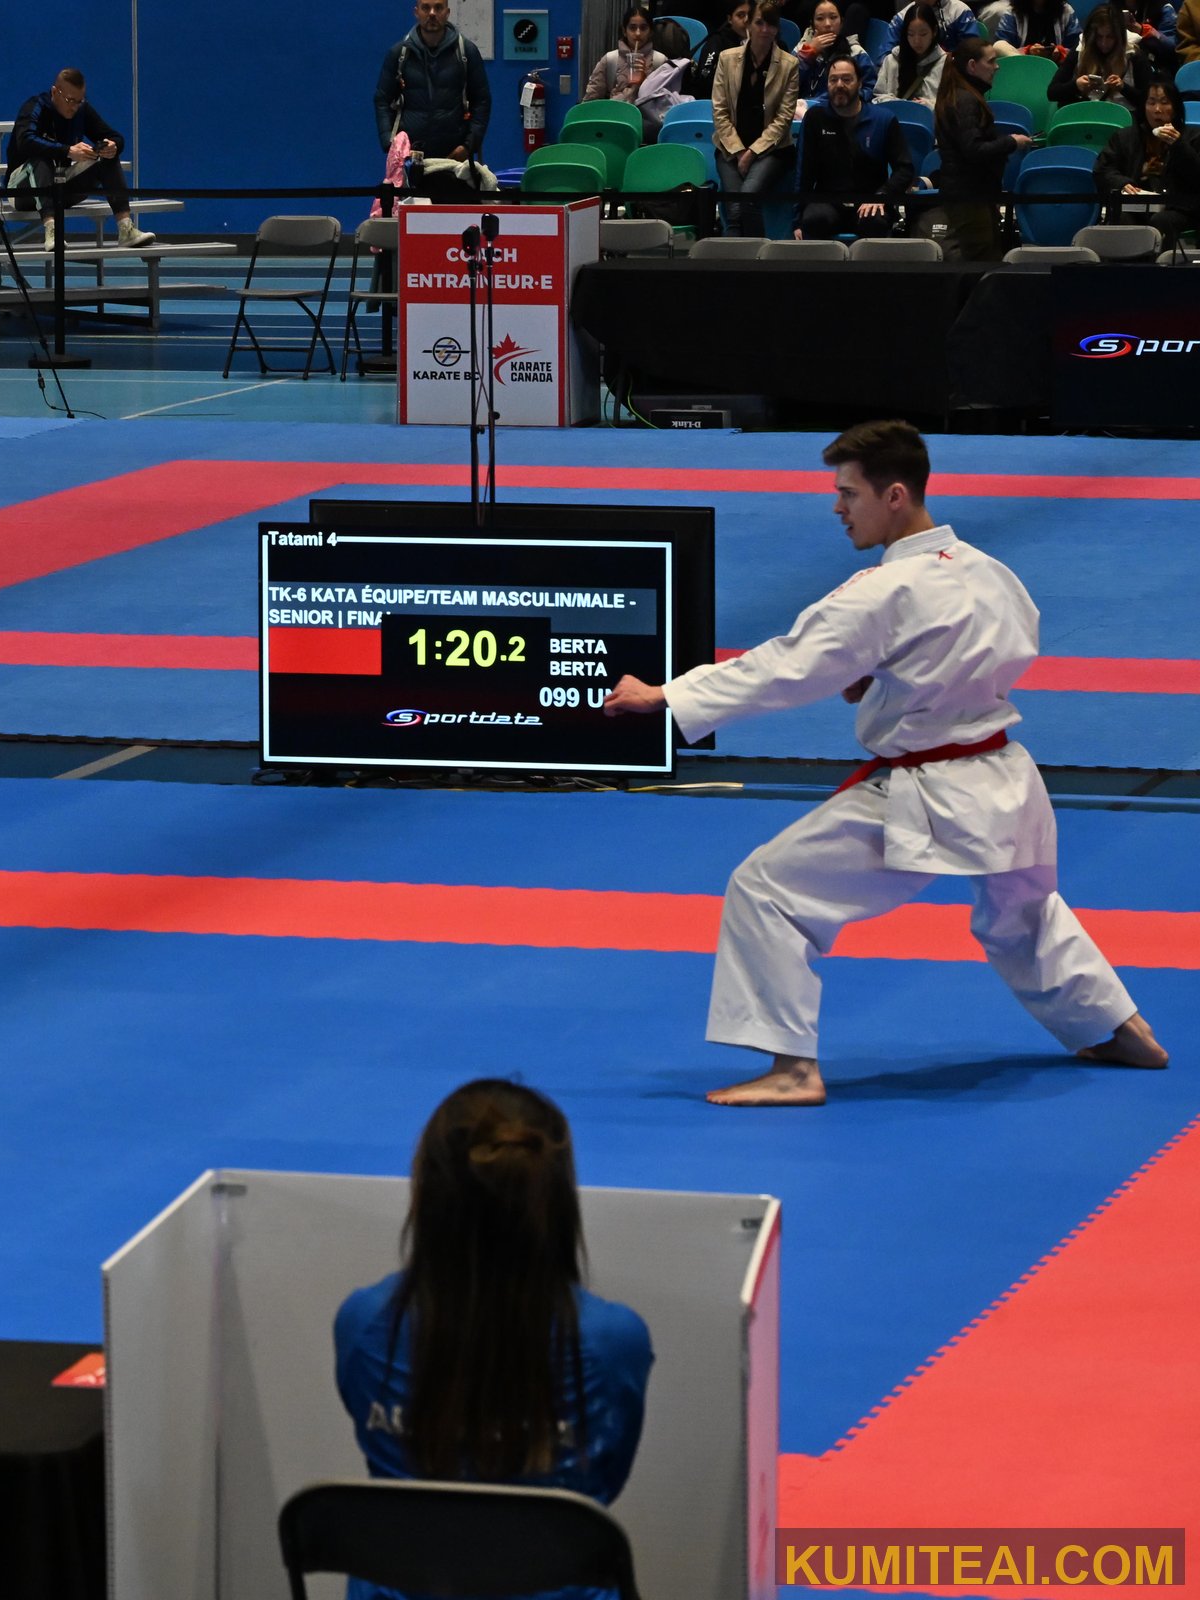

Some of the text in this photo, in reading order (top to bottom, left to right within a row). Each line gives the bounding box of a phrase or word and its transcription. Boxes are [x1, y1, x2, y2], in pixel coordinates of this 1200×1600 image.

[512, 361, 552, 372] KARATE
[413, 371, 480, 380] KARATE BC
[511, 372, 553, 383] CANADA
[268, 531, 338, 547] Tatami 4
[269, 587, 307, 602] TK-6
[311, 588, 358, 603] KATA
[361, 585, 478, 606] ÉQUIPE/TEAM
[482, 590, 626, 609] MASCULIN/MALE
[269, 609, 334, 625] SENIOR
[347, 610, 391, 626] FINA
[408, 628, 526, 668] 1:20.2
[539, 687, 580, 707] 099
